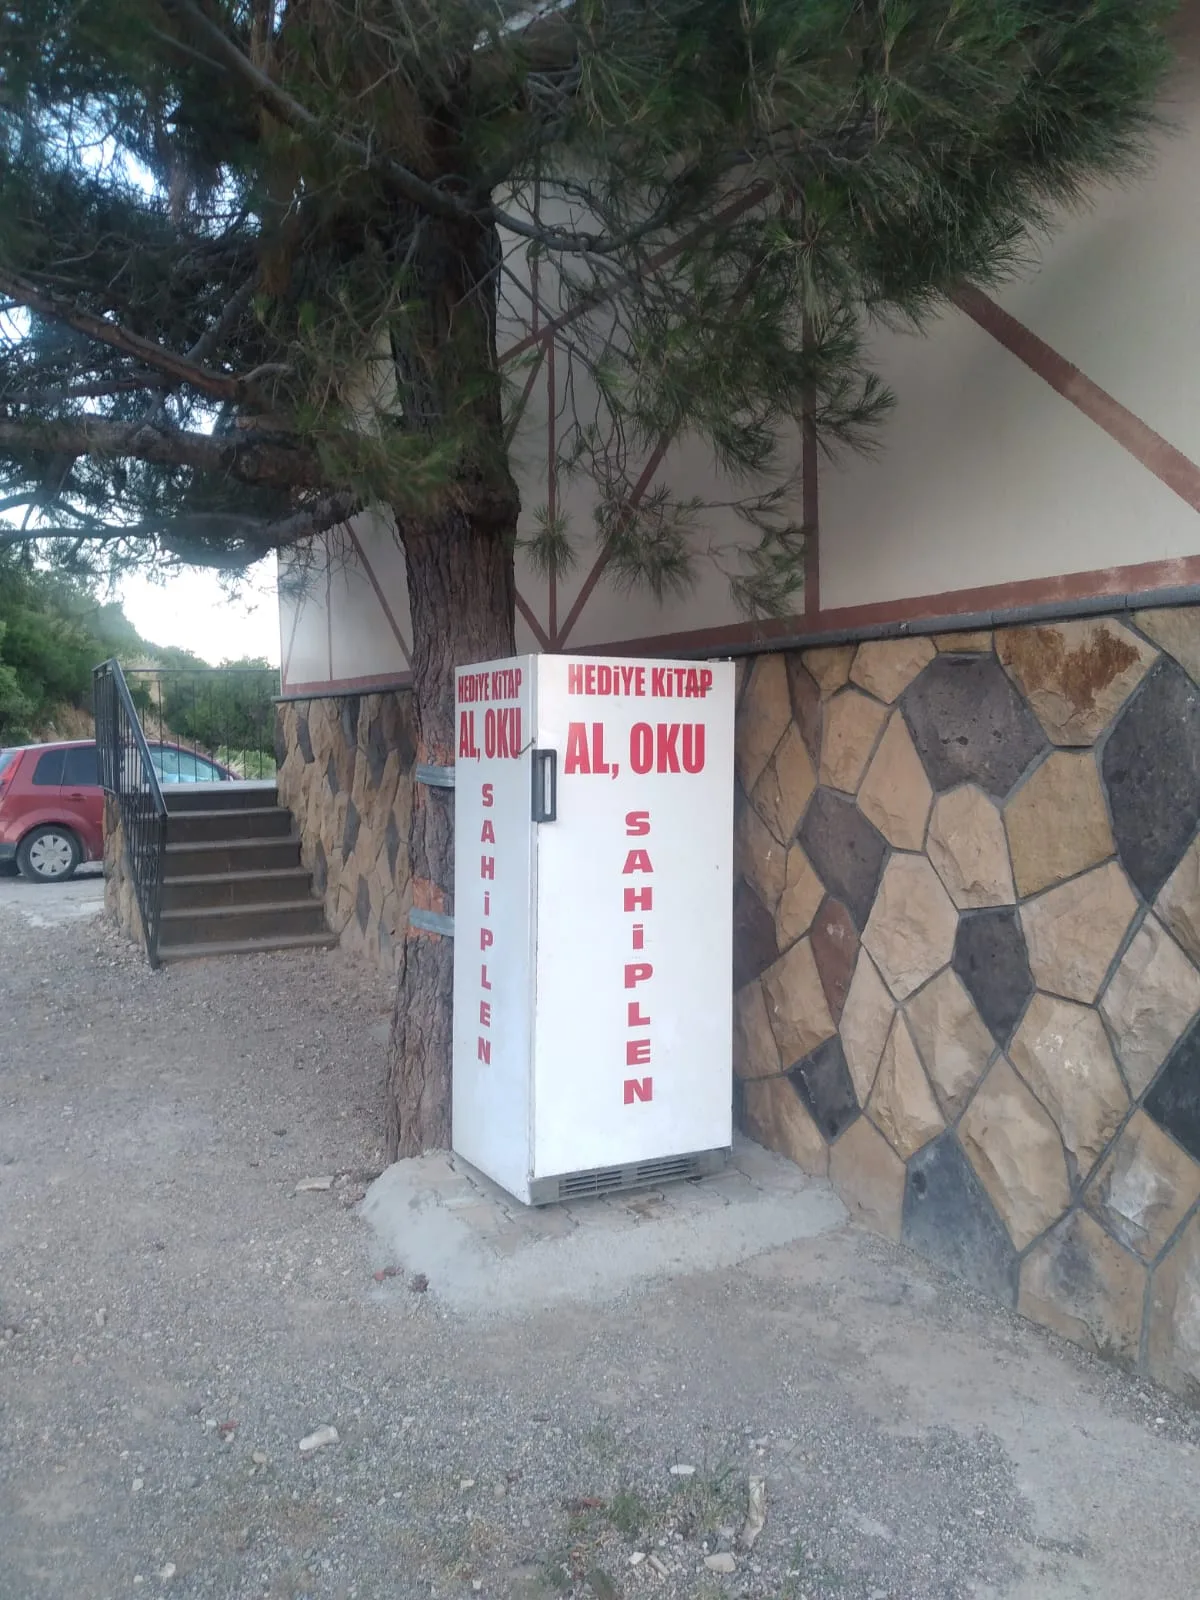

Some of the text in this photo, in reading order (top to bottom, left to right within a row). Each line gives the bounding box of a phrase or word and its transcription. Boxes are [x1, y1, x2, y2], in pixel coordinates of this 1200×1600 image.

[459, 707, 522, 762] AL, OKU
[564, 722, 706, 780] AL, OKU
